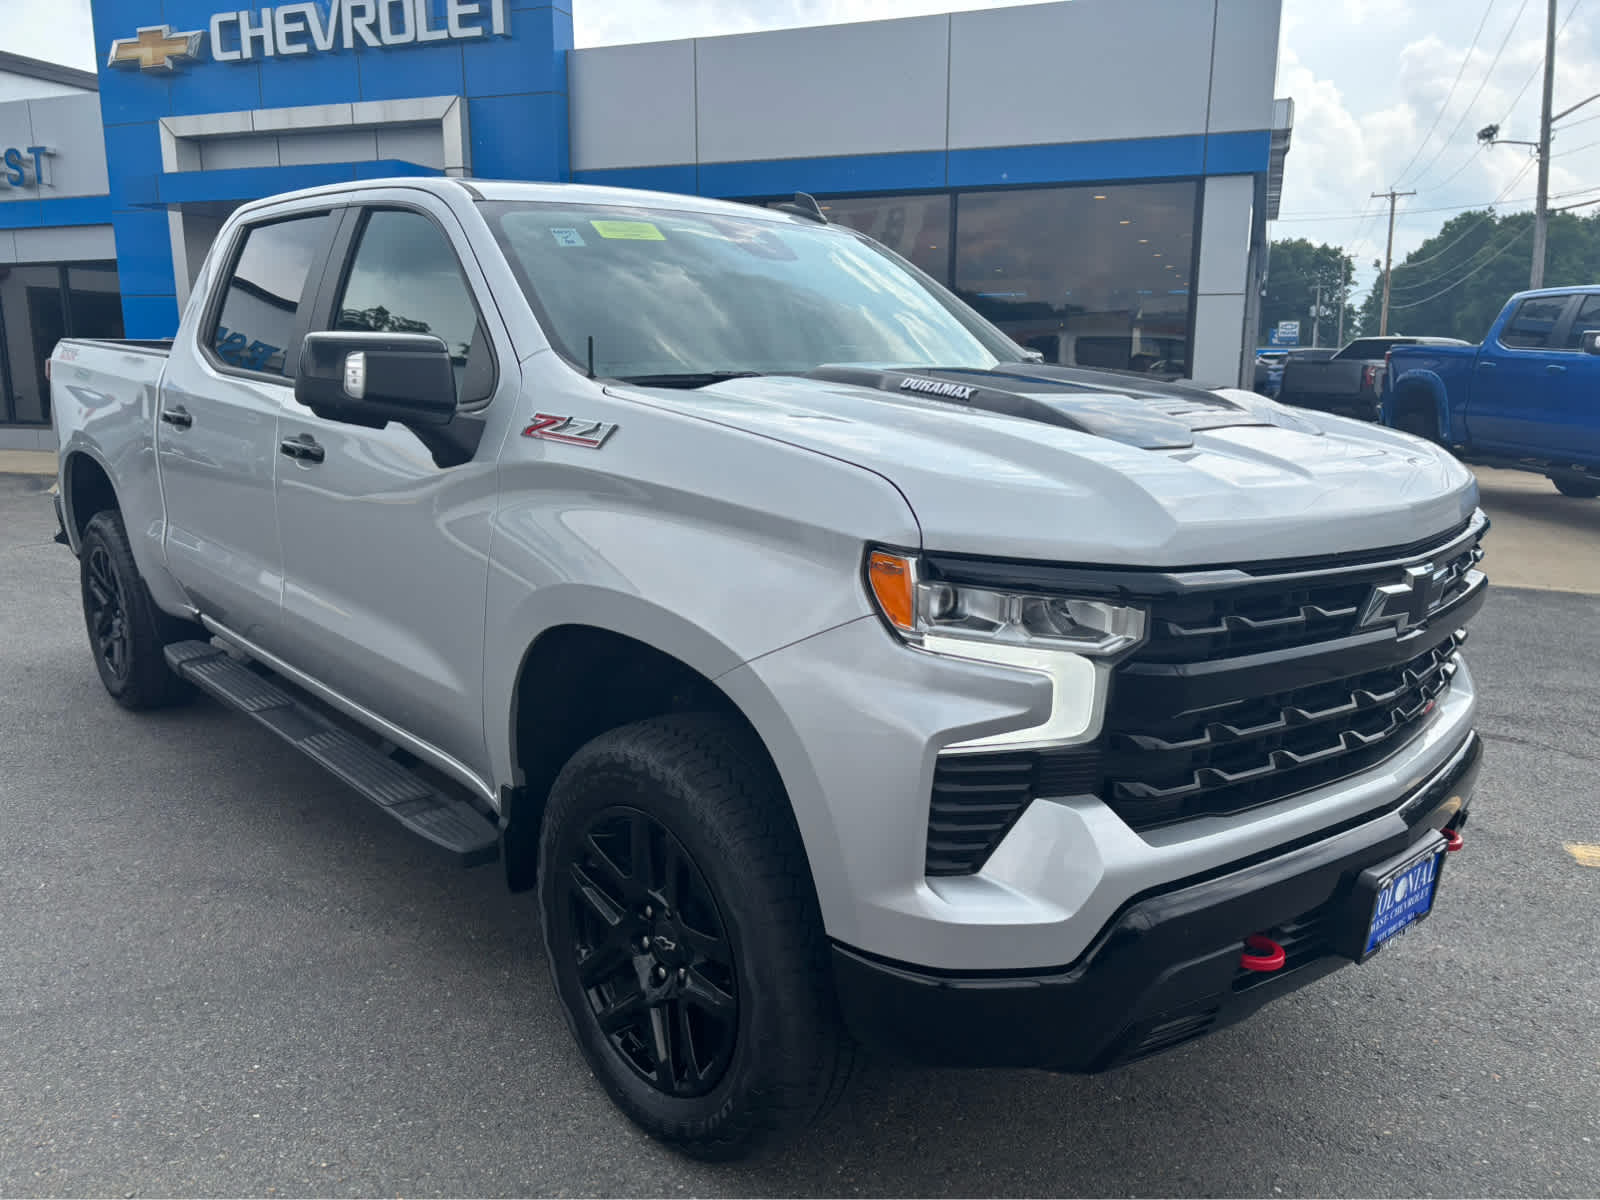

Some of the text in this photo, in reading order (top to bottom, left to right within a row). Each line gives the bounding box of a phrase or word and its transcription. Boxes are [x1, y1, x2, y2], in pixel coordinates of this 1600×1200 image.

[209, 0, 510, 61] CHEVROLET
[1, 145, 50, 188] ST
[900, 377, 975, 400] DURAMAX
[521, 411, 618, 449] Z71
